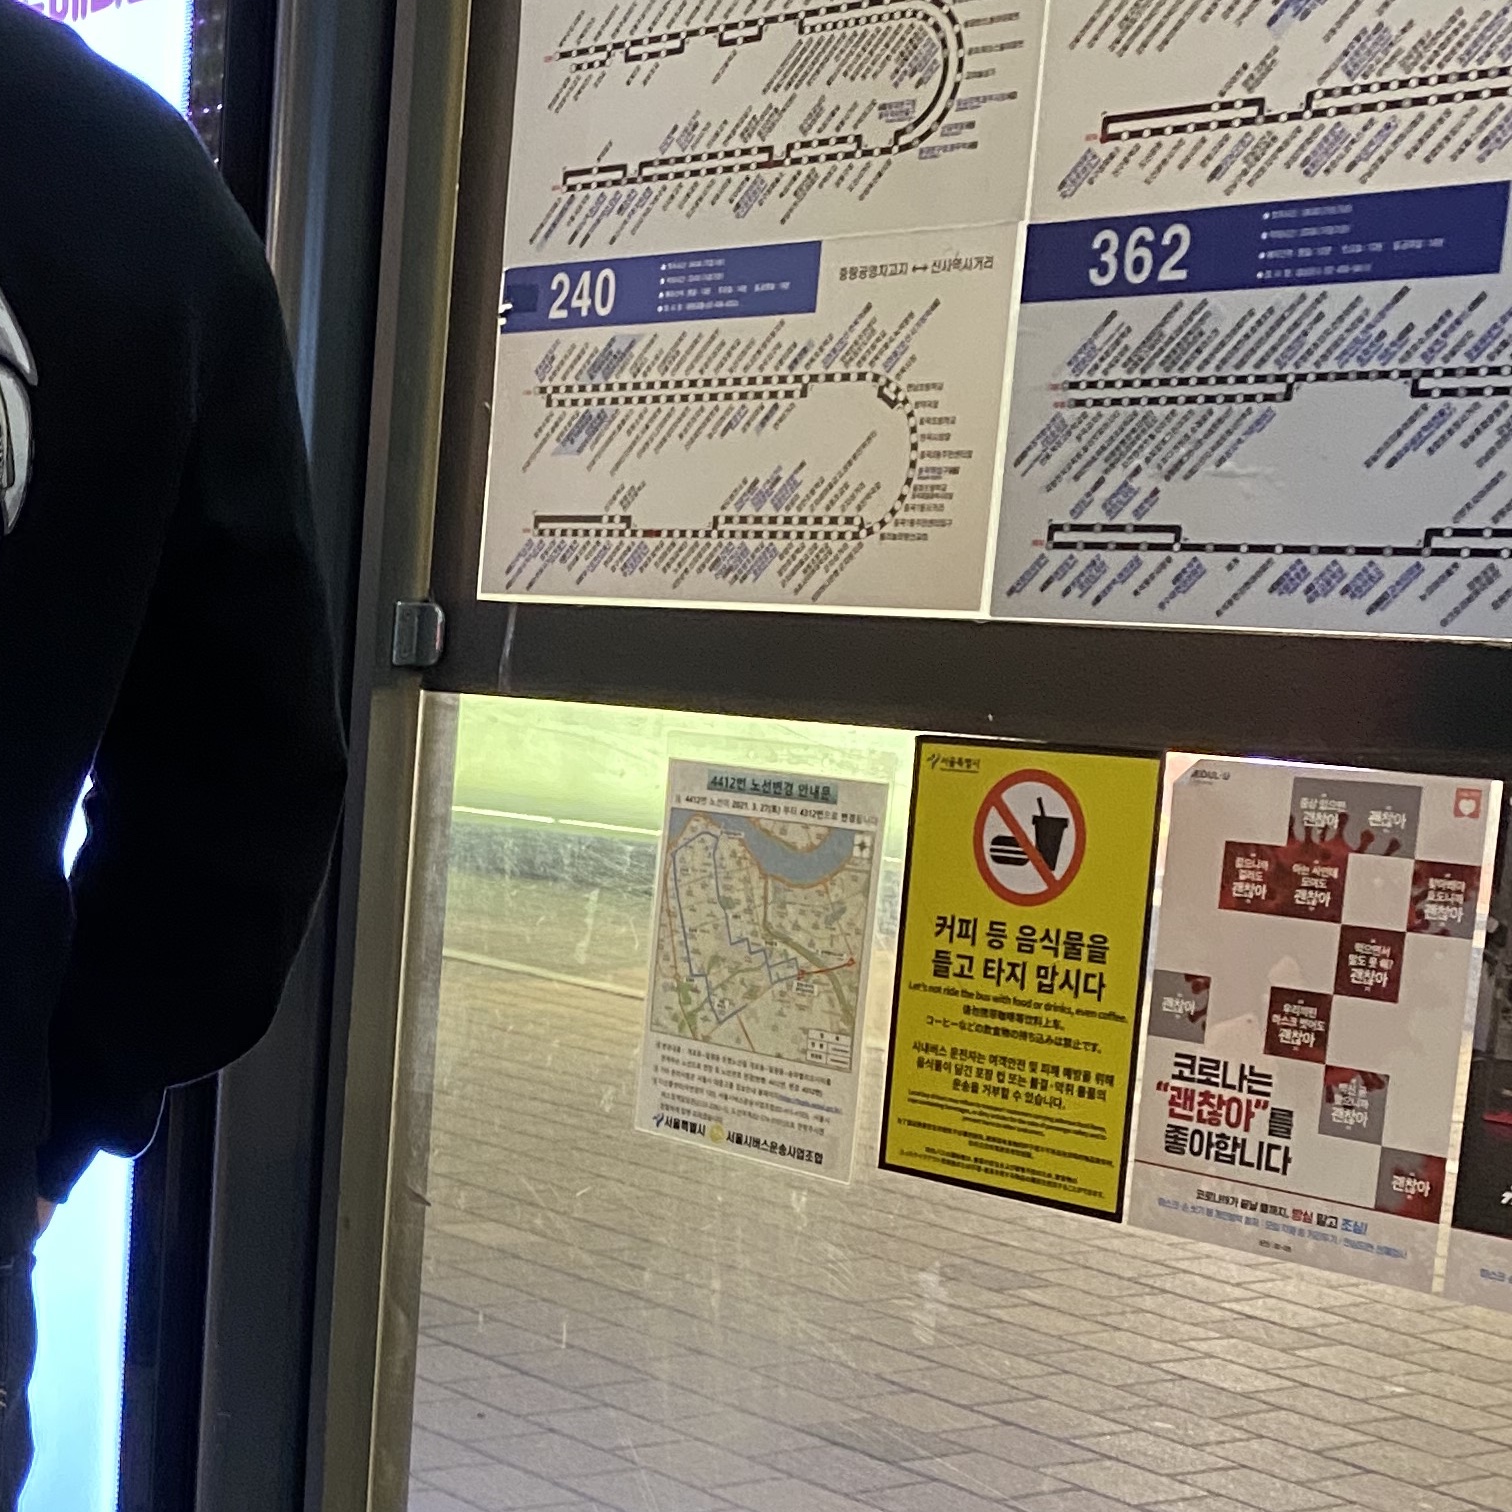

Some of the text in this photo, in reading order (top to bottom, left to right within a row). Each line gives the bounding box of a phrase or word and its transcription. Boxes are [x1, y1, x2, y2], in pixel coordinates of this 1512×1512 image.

[1089, 223, 1191, 286] 362
[548, 268, 616, 319] 240
[711, 774, 832, 801] 4412번 노선변경 안내문
[935, 914, 1109, 965] 커피 등 음식물을
[932, 949, 1106, 1002] 들고 타지 맙시다
[1171, 1052, 1273, 1098] 코로나는
[664, 1115, 824, 1165] 서울특별시 서울시버스운송사업조합
[1164, 1123, 1292, 1176] 좋아합니다
[1392, 1173, 1431, 1197] 괜찮아
[1291, 1208, 1313, 1224] 방심
[1341, 1218, 1368, 1235] 조심!
